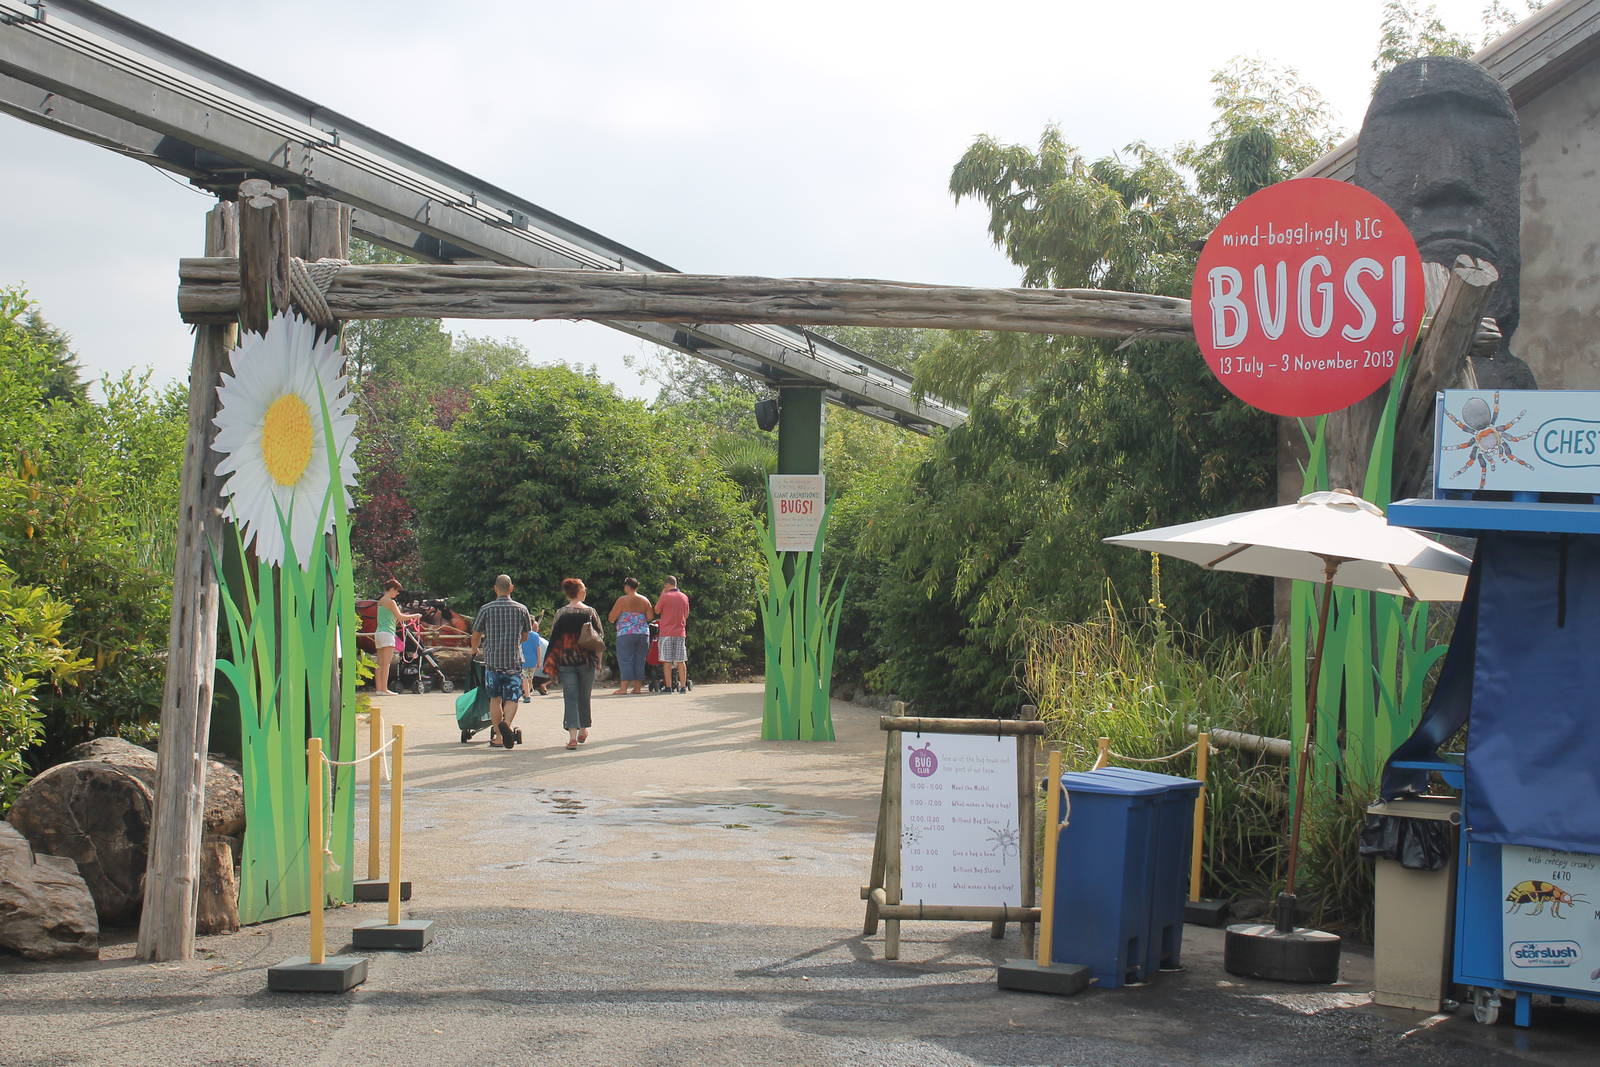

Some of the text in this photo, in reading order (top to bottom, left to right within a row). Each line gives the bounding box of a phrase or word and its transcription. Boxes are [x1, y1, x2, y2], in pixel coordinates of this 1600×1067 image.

[1222, 217, 1383, 247] mind-bogglingly BIG
[1207, 255, 1406, 350] BUGS!
[1219, 356, 1232, 375] 13
[1236, 355, 1264, 378] July
[1281, 354, 1290, 372] 3
[1294, 351, 1359, 372] November
[1362, 350, 1395, 369] 2013
[1543, 429, 1600, 455] CHES
[780, 499, 813, 515] BUGS!
[914, 756, 932, 768] BUG
[1514, 946, 1578, 959] starslush
